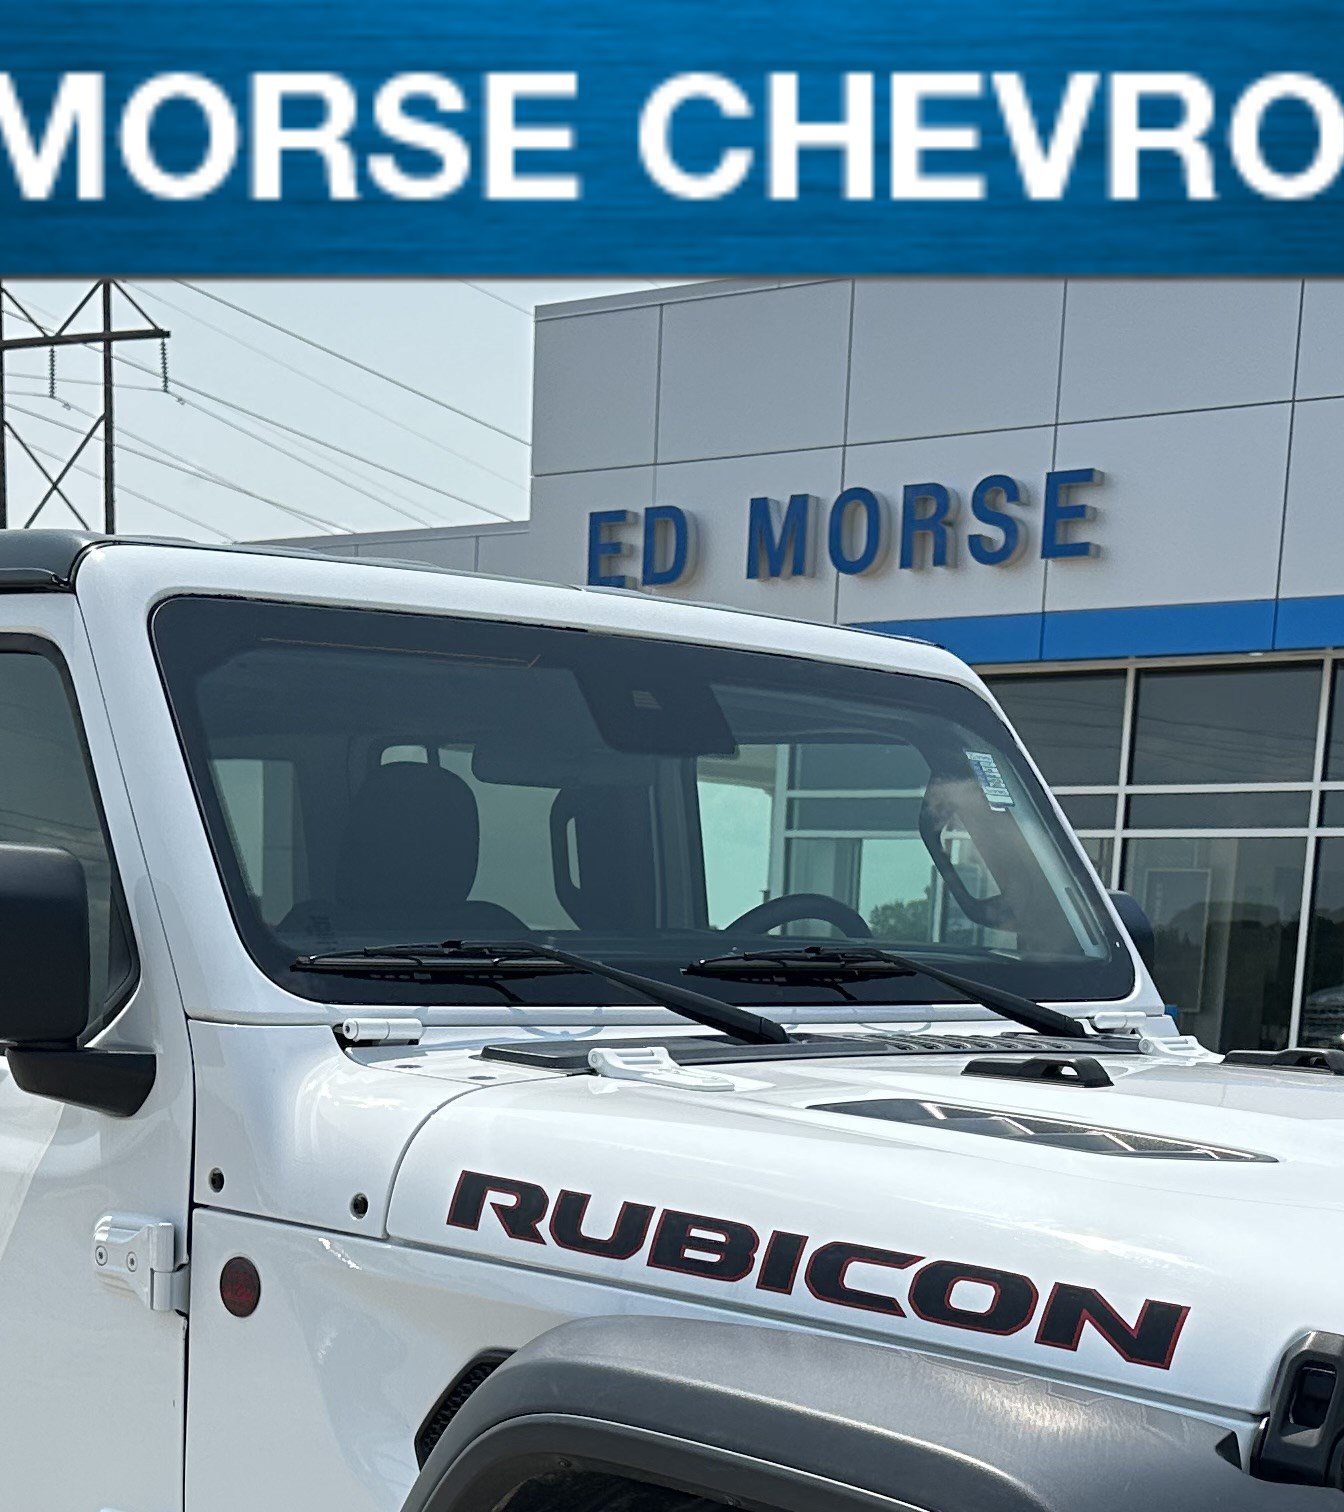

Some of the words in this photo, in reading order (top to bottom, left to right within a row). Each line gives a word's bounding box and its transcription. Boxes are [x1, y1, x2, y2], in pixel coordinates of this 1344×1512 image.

[587, 506, 694, 588] ED
[745, 468, 1103, 580] MORSE
[446, 1169, 1190, 1370] RUBICON
